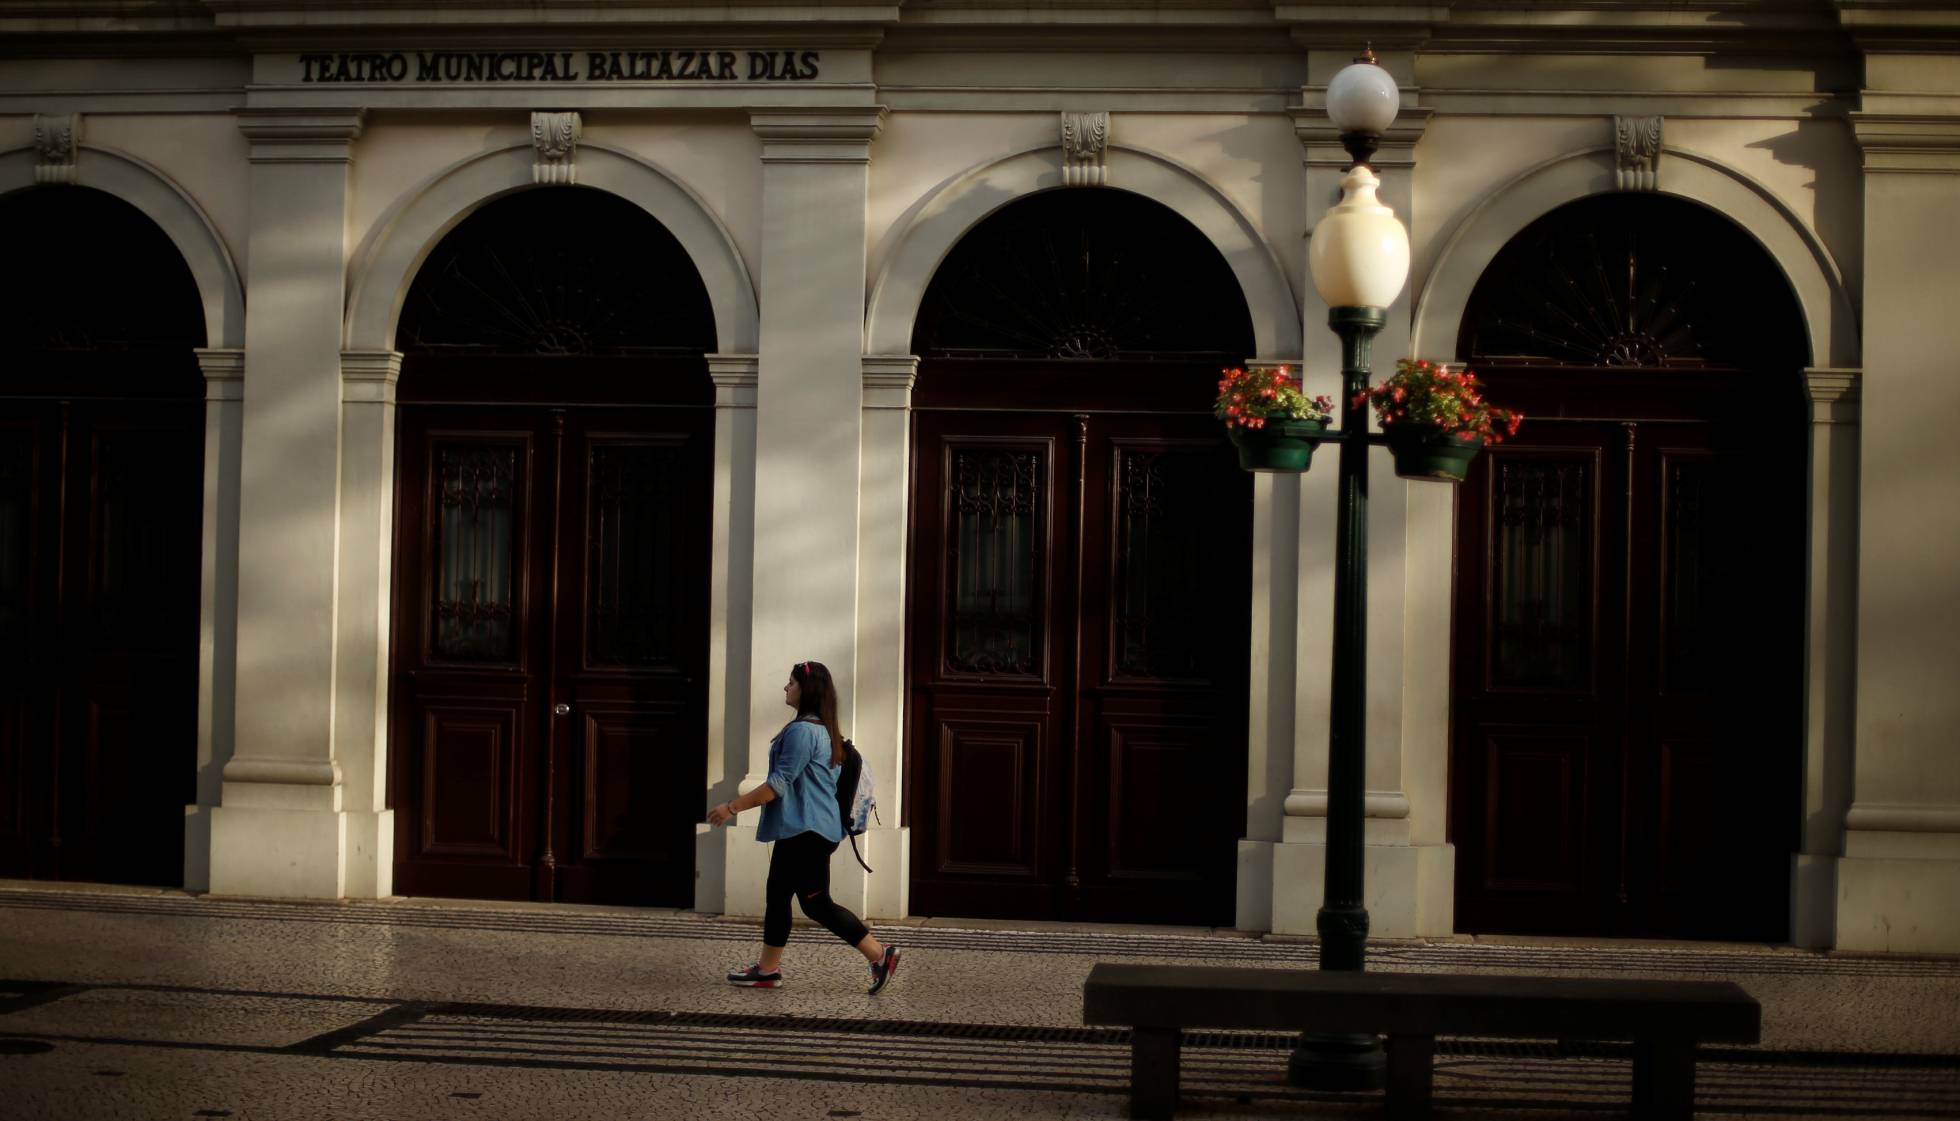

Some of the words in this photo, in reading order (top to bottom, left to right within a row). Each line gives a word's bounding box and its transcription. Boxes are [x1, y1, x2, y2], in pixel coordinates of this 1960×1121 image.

[300, 53, 407, 82] TEATRO
[416, 52, 578, 81] MUNICIPAL
[587, 52, 737, 80] BALTAZAR
[748, 52, 819, 80] DIAS
